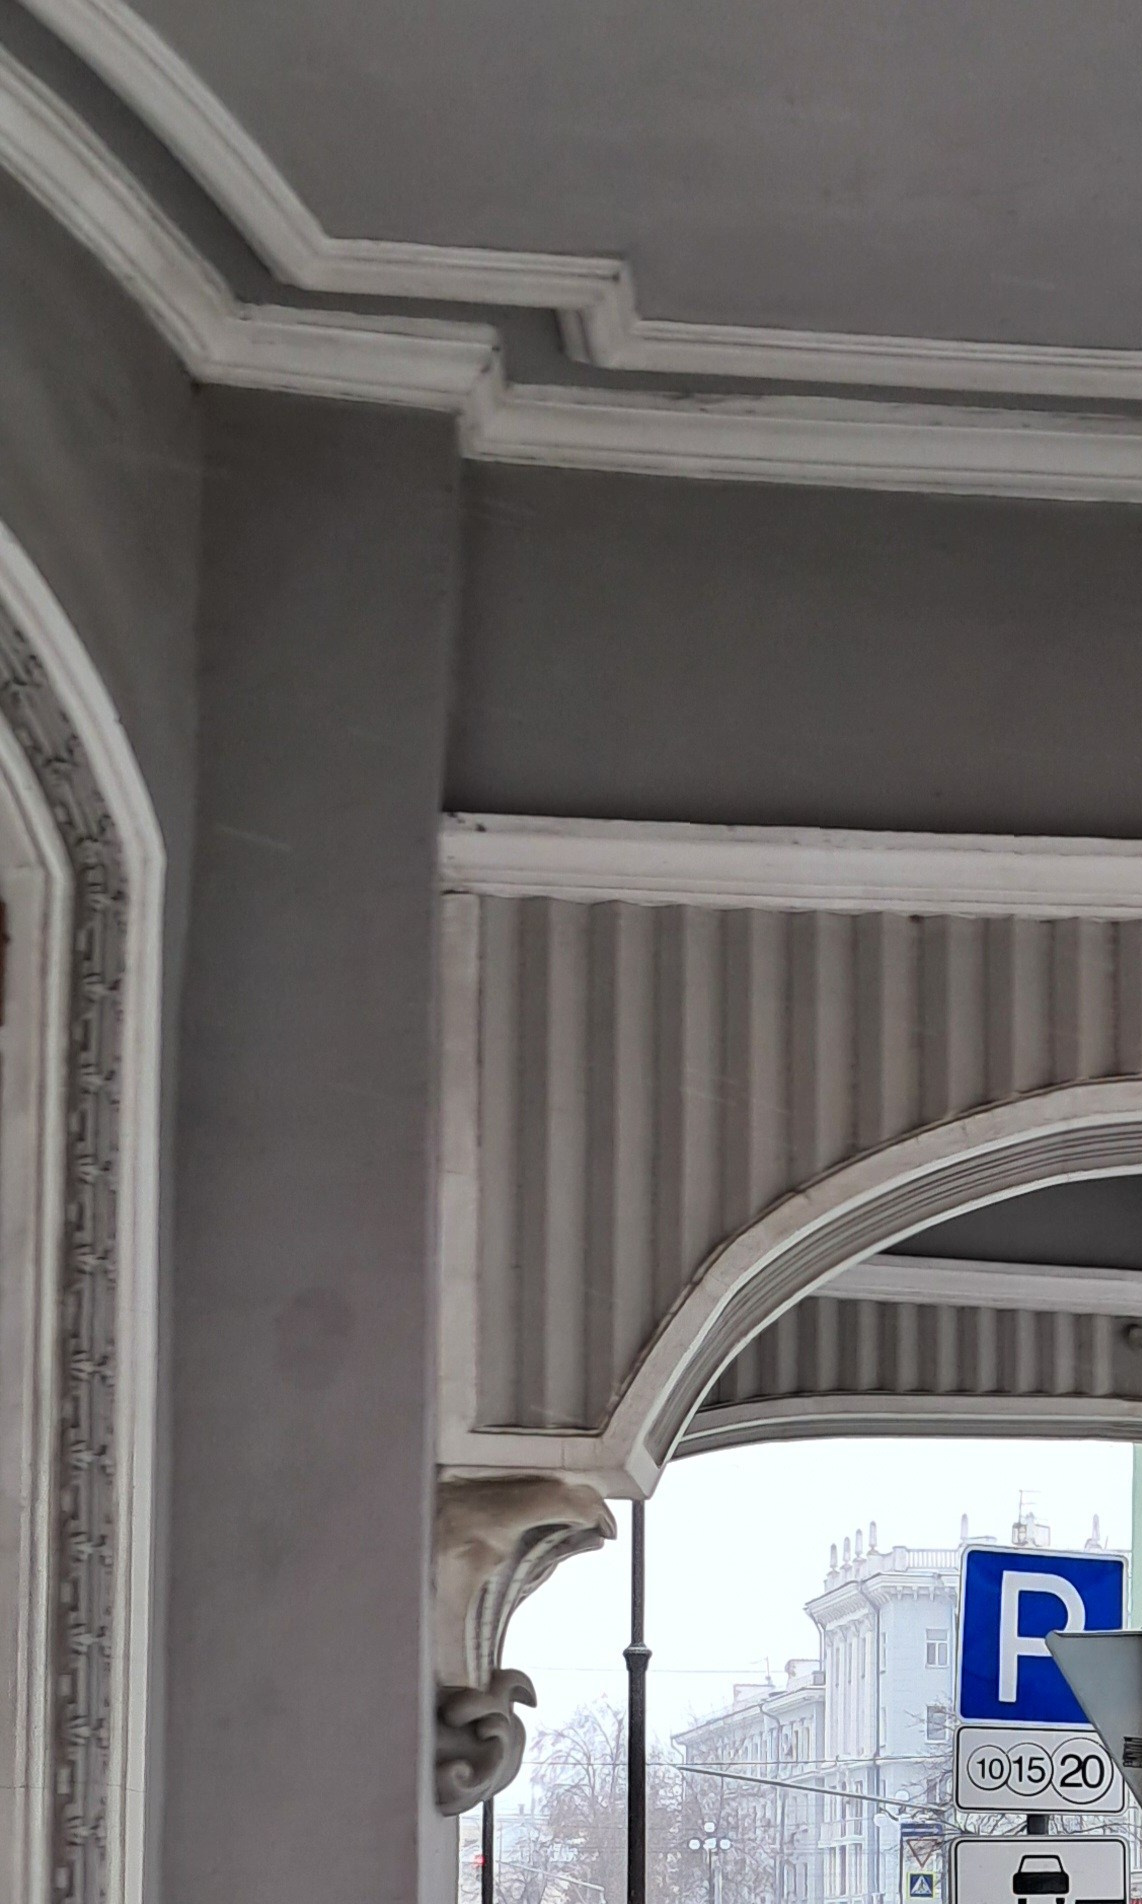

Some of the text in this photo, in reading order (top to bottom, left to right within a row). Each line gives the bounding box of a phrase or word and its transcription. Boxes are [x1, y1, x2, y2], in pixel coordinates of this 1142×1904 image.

[998, 1570, 1086, 1703] P
[977, 1755, 1104, 1788] 10 15 20
